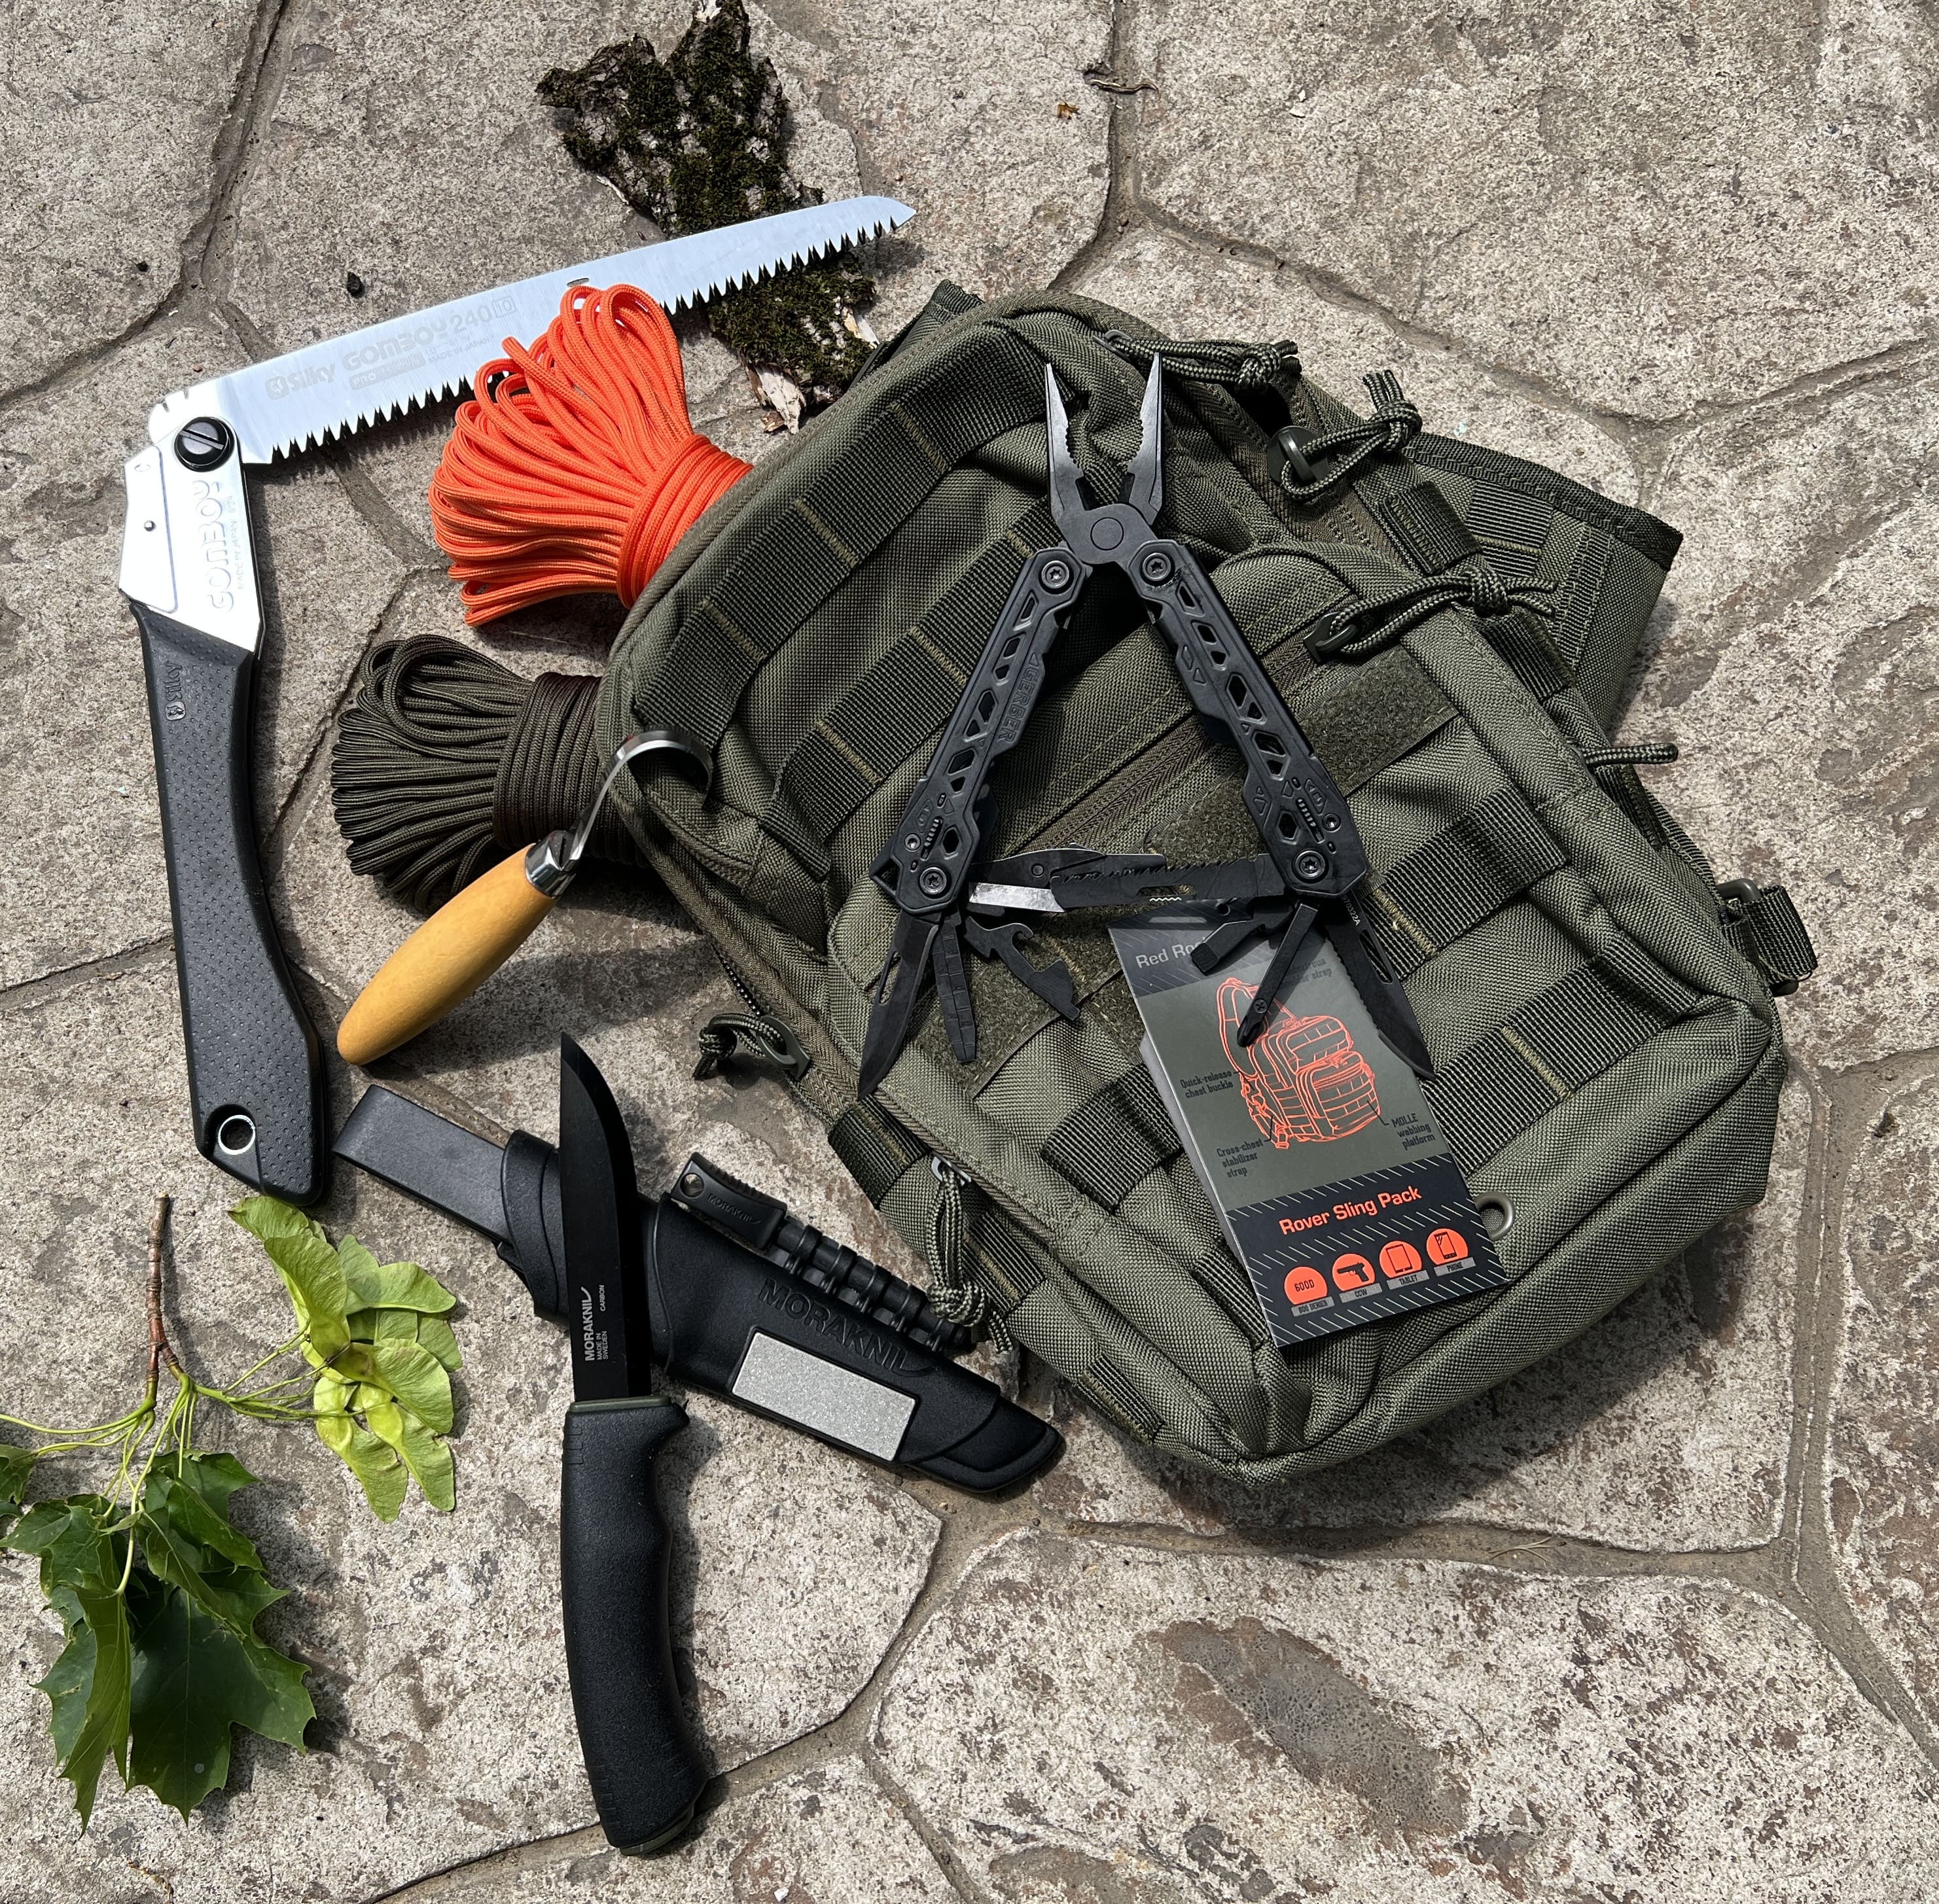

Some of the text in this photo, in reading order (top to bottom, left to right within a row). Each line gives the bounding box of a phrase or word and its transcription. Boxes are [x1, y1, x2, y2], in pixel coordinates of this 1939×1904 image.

[450, 305, 493, 334] 240
[496, 298, 513, 314] 10
[998, 667, 1040, 743] GERBER
[1135, 937, 1205, 968] Red Ro
[1312, 968, 1332, 979] strap
[1180, 1070, 1232, 1088] Quick-release
[1185, 1080, 1234, 1099] chest buckle
[1391, 1113, 1418, 1127] MOLLE
[1397, 1123, 1431, 1137] webbing
[1217, 1138, 1264, 1157] Cross-chest
[1402, 1135, 1436, 1150] platform
[1222, 1152, 1258, 1168] stabilizer
[1226, 1166, 1247, 1178] strap
[1279, 1186, 1423, 1235] Rover Sling Pack
[1446, 1261, 1463, 1272] PHONE
[1294, 1279, 1315, 1292] 600D
[1398, 1274, 1418, 1286] TABLET
